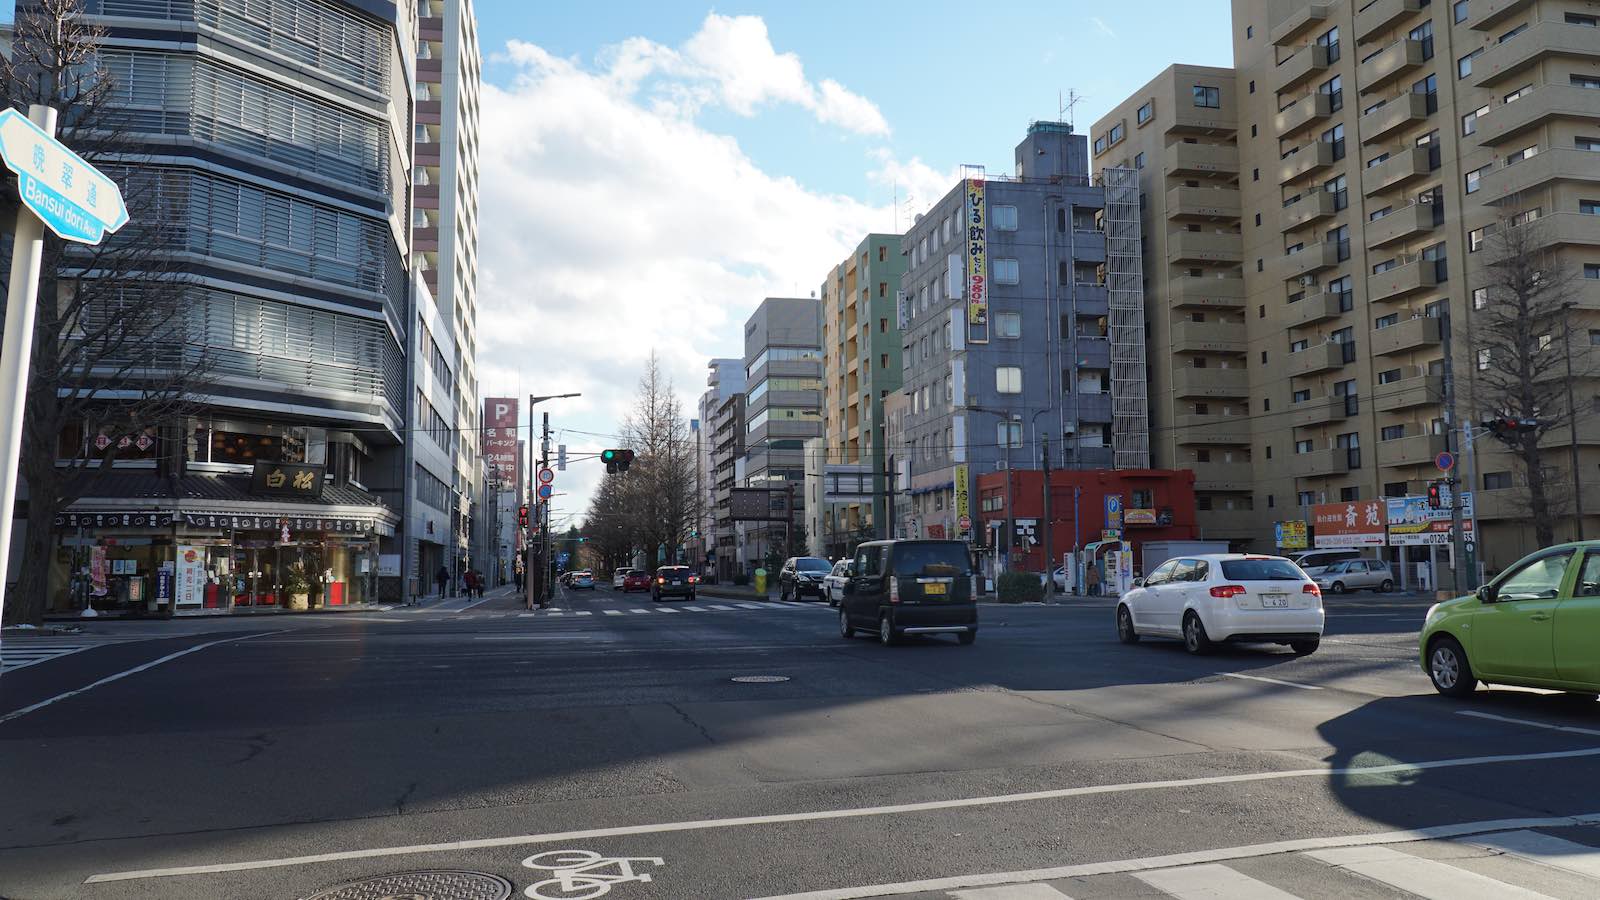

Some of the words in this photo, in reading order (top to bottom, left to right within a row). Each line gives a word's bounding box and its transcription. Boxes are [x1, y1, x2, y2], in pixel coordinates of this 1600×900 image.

[32, 143, 98, 209] 晩翠通
[25, 175, 64, 217] Bansui
[65, 206, 84, 230] dori
[496, 403, 509, 420] P
[487, 428, 516, 438] 名和
[487, 453, 515, 462] 24時間
[266, 469, 315, 490] 白松
